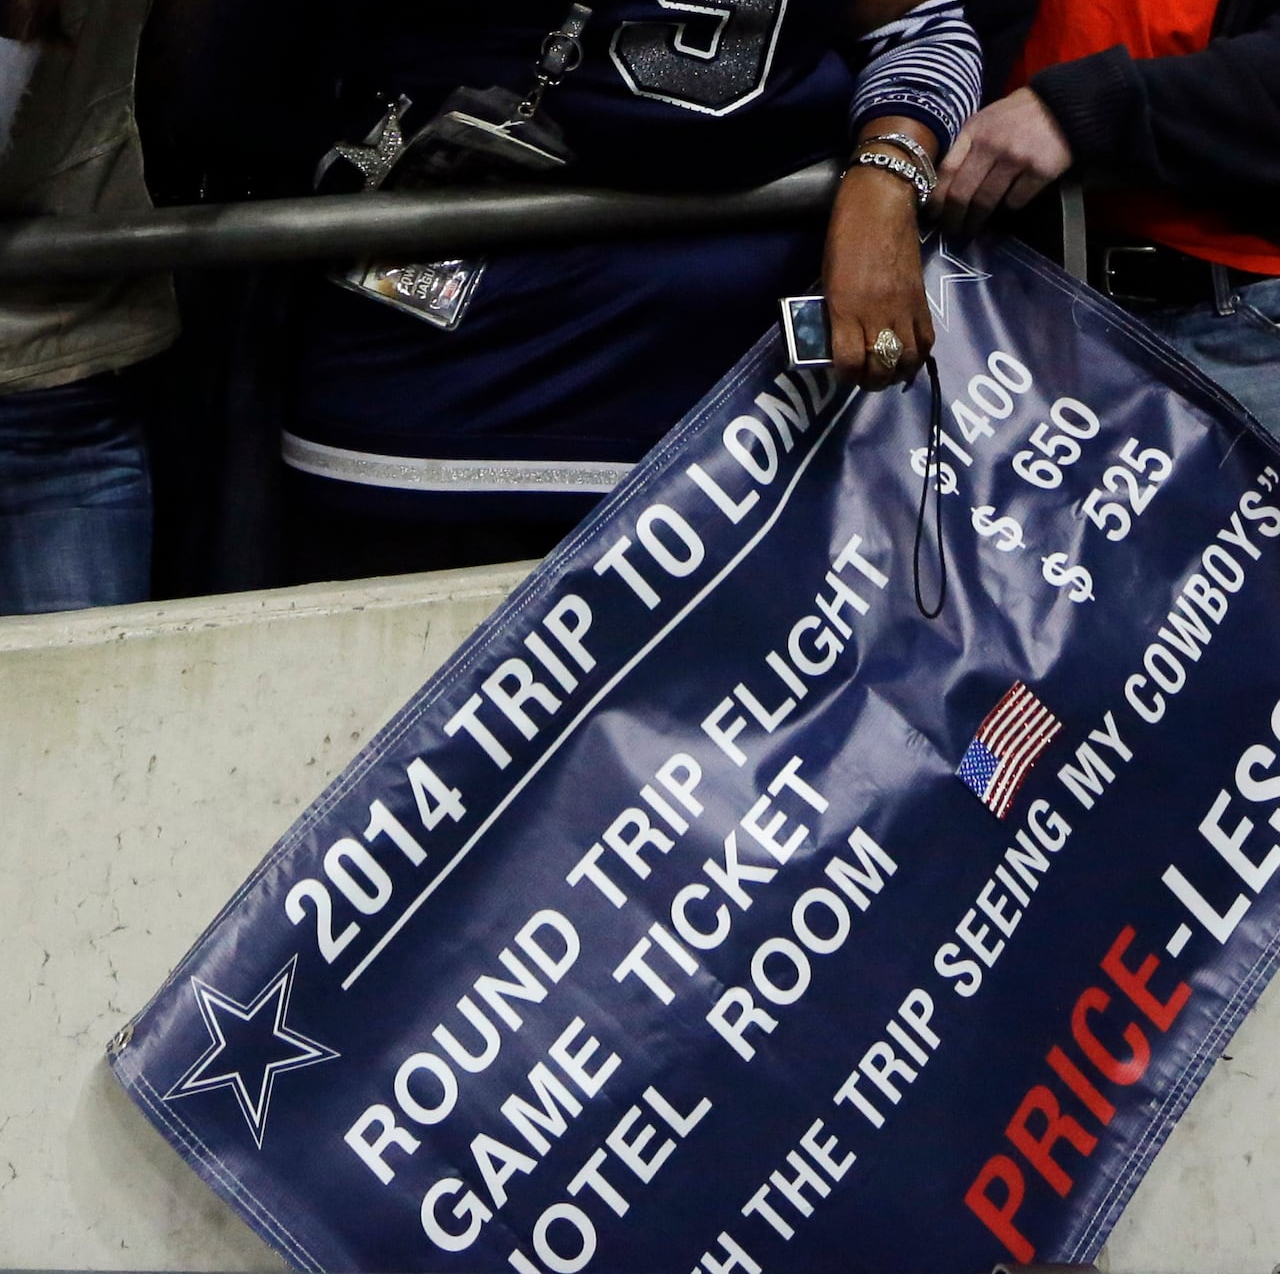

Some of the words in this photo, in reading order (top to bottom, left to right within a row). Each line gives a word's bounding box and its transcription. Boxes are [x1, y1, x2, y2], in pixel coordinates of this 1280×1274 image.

[284, 757, 467, 964] 2014
[443, 594, 597, 771] TRIP
[594, 504, 705, 610] TO
[343, 909, 581, 1185] ROUND
[565, 752, 704, 908] TRIP
[700, 535, 889, 767] FLIGHT
[910, 350, 1033, 495] $1400
[420, 1016, 621, 1252] GAME
[612, 756, 829, 1005] TICKET
[1011, 397, 1101, 490] 650
[705, 826, 897, 1062] ROOM
[1081, 437, 1174, 543] 525
[741, 1118, 857, 1241] THE
[833, 988, 941, 1129] TRIP
[933, 798, 1073, 998] SEEING
[1057, 710, 1134, 810] MY
